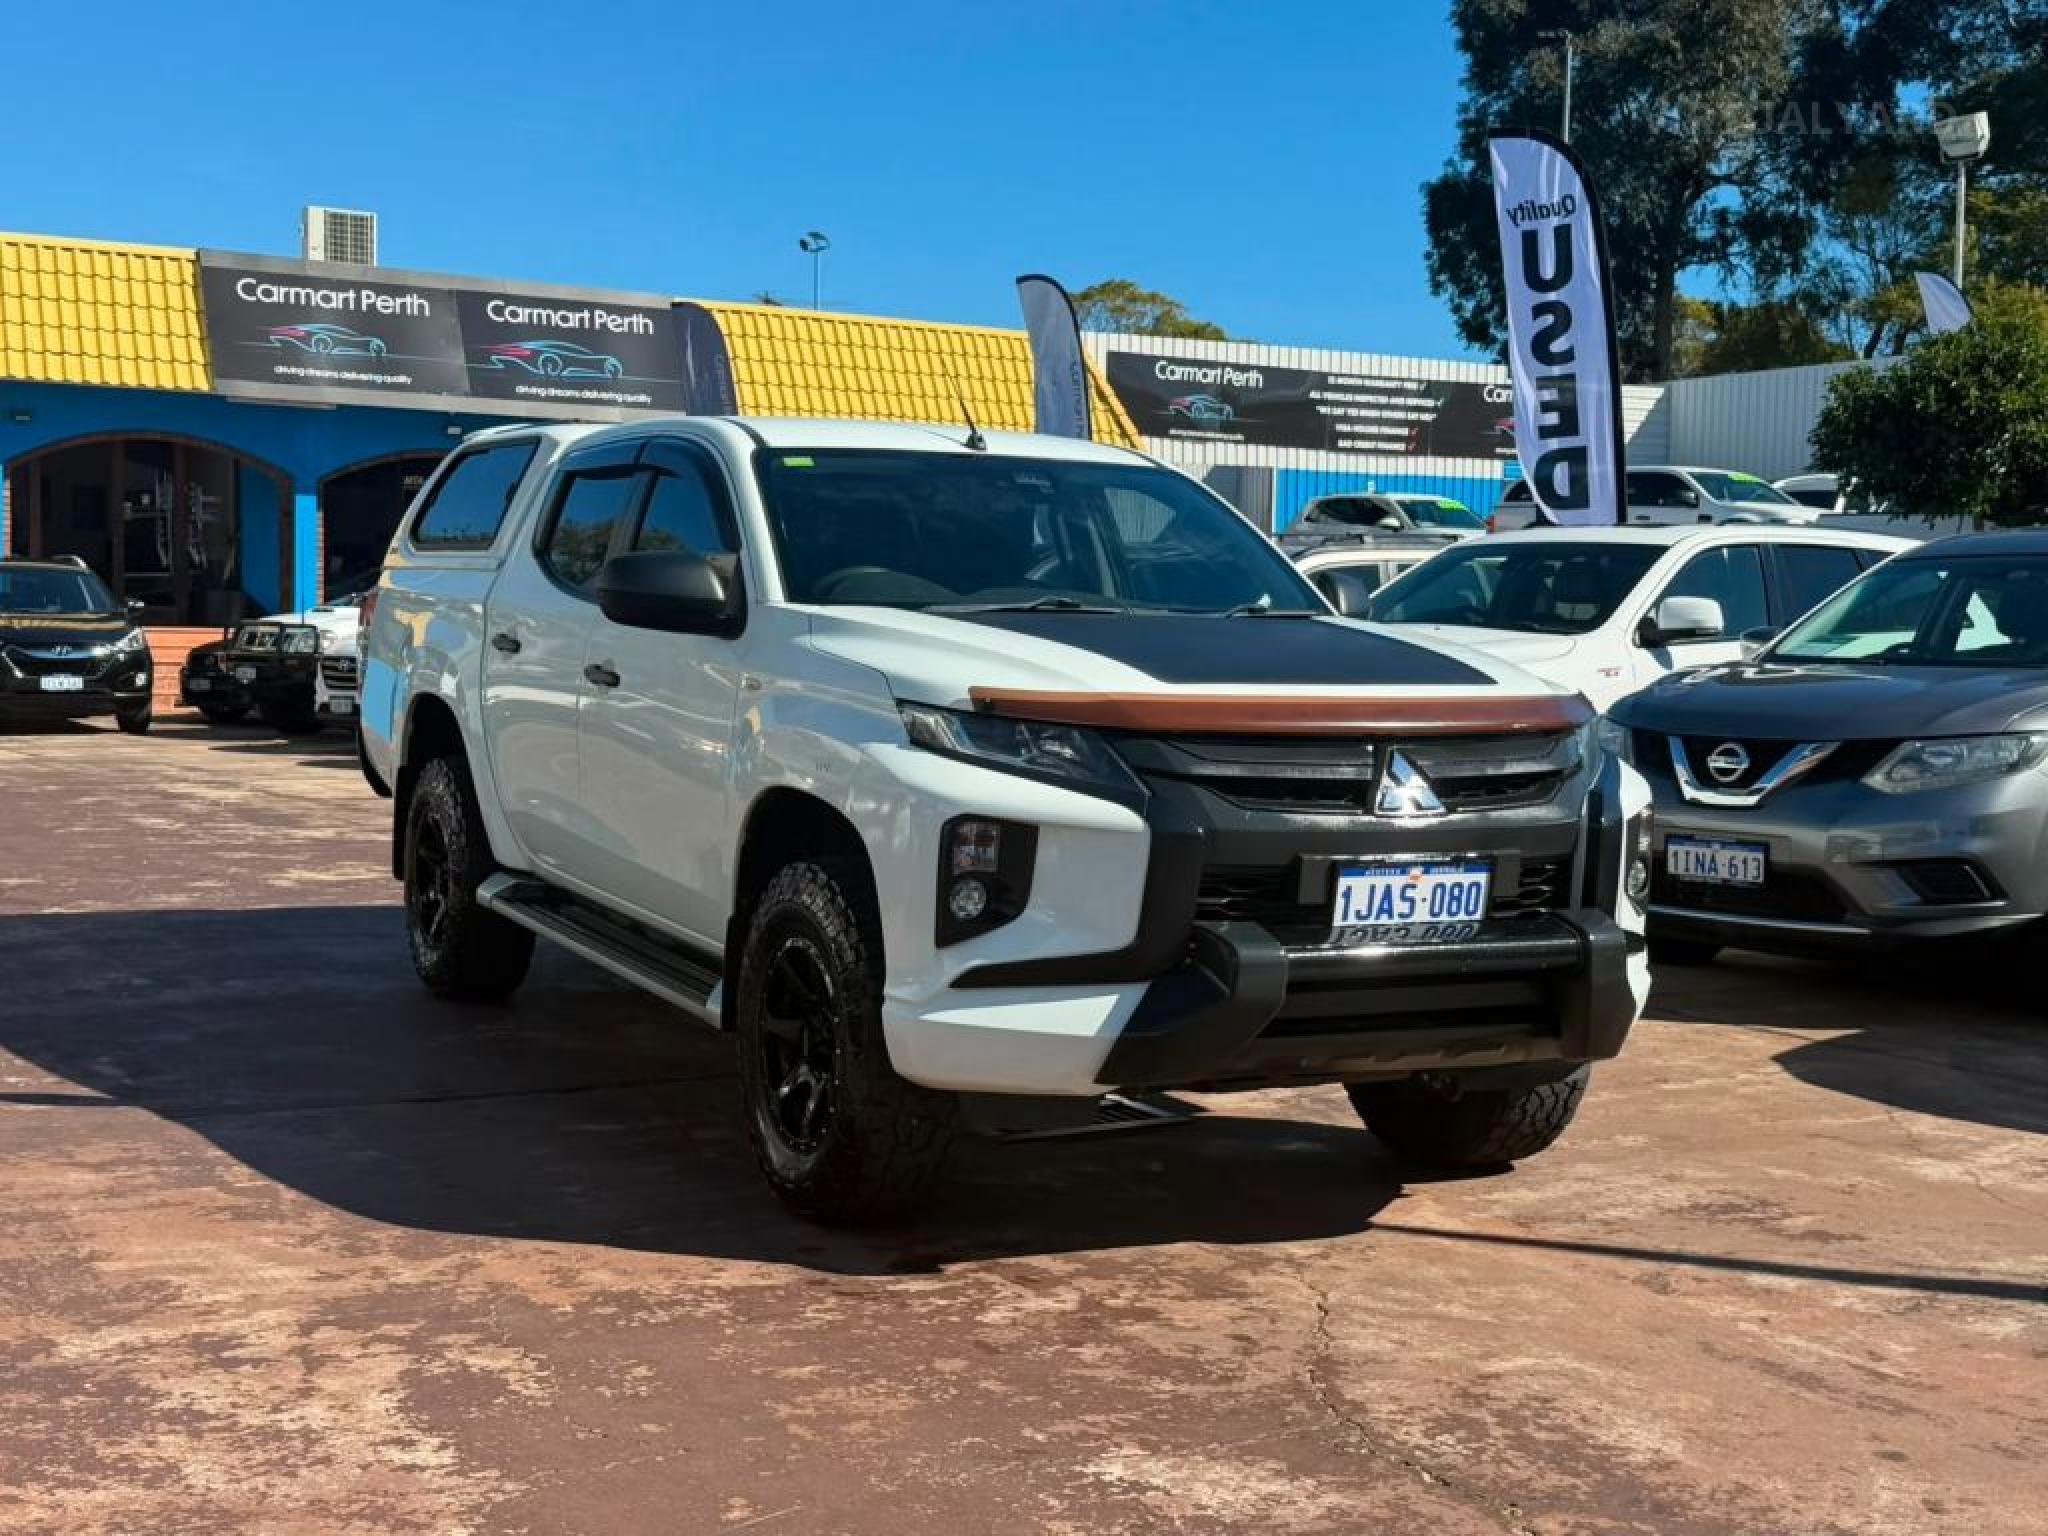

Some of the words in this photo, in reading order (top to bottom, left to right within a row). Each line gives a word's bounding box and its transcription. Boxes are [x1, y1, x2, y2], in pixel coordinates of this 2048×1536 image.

[236, 277, 356, 310] Carmart
[361, 289, 431, 317] Perth
[487, 299, 590, 329] Carmart
[594, 310, 655, 335] Perth
[1155, 360, 1222, 384] Carmart
[1223, 367, 1264, 389] Perth
